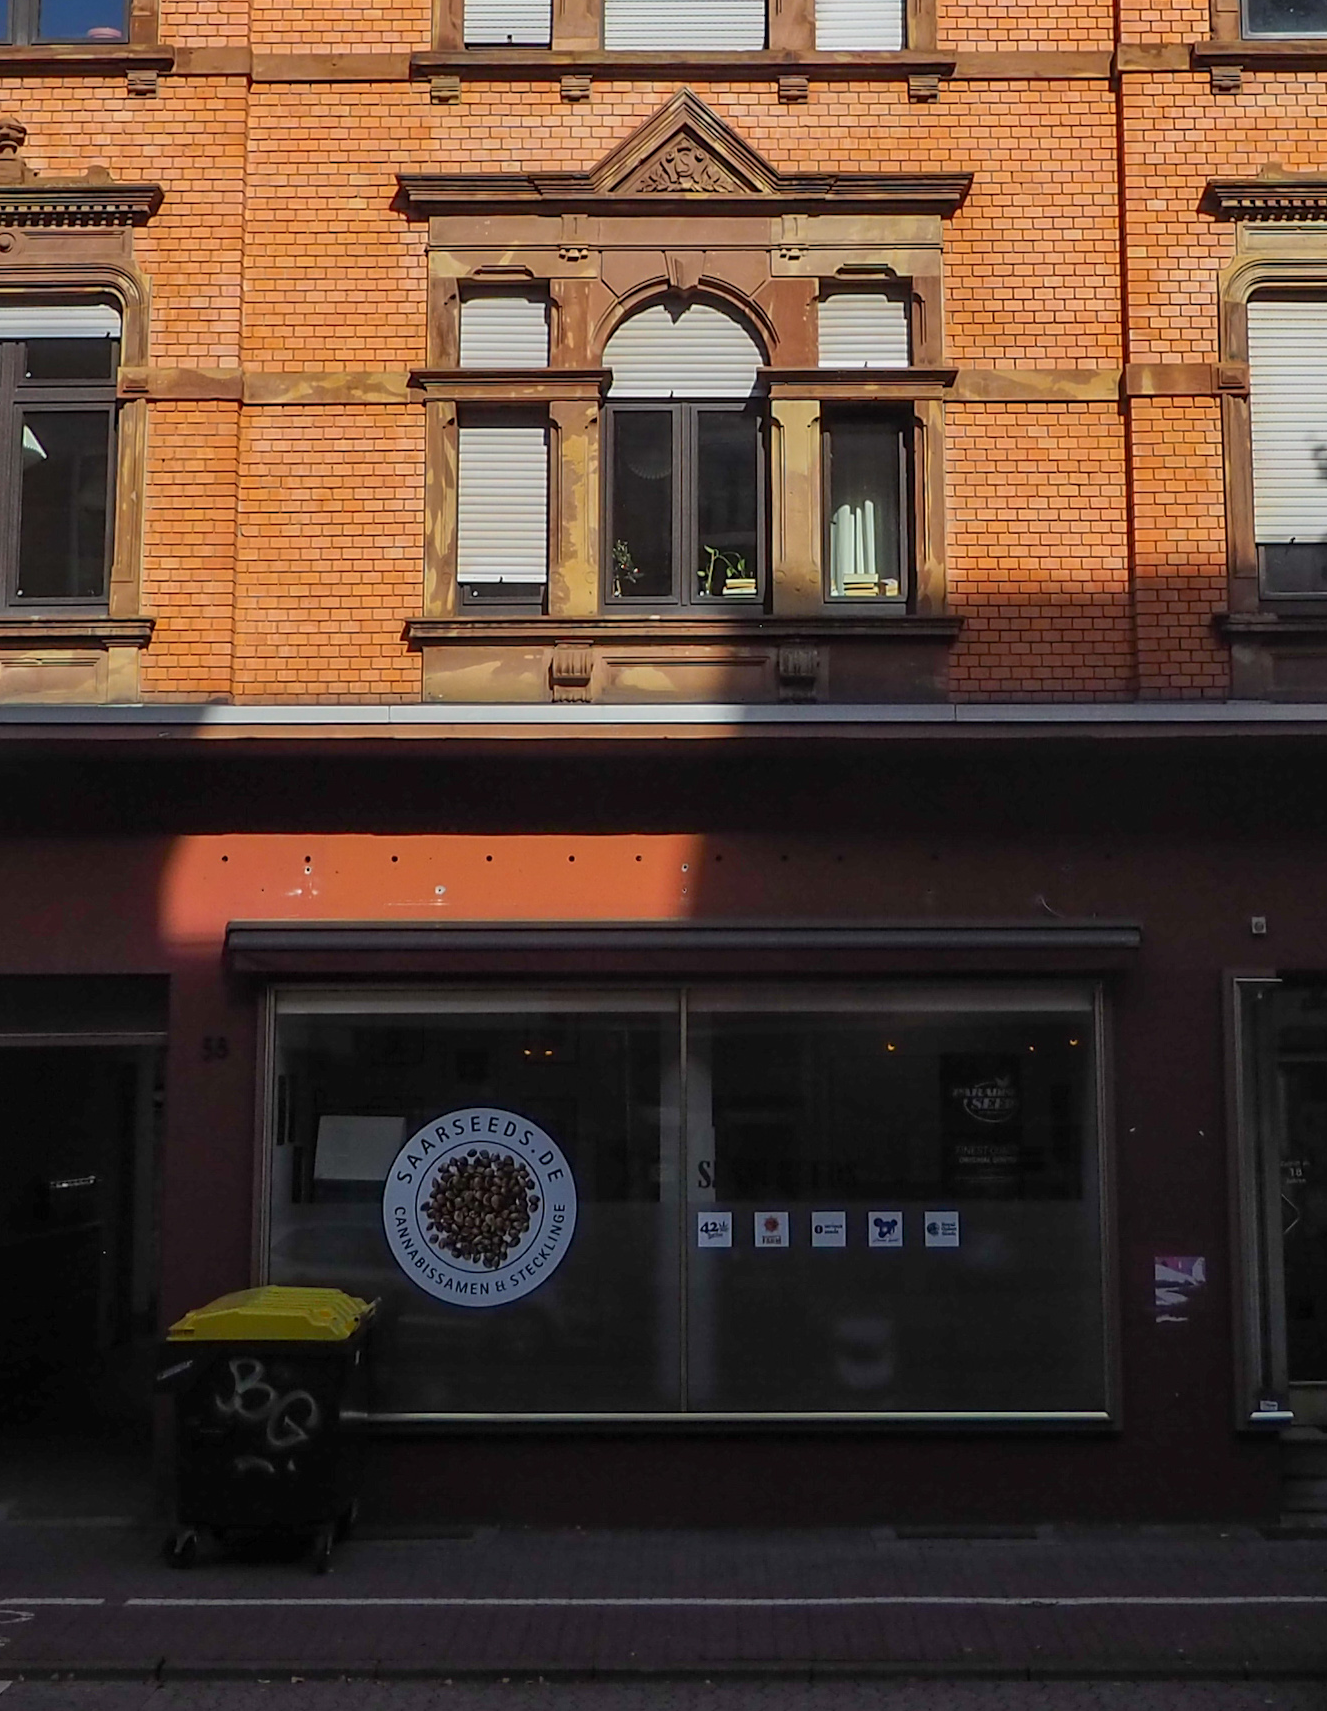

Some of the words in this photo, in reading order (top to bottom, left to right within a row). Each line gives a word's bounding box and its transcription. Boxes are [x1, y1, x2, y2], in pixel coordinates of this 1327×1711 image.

[397, 1116, 564, 1184] SAARSEEDS.DE
[394, 1207, 489, 1295] CANNABISSAMEN
[510, 1204, 566, 1288] STECKLINGE
